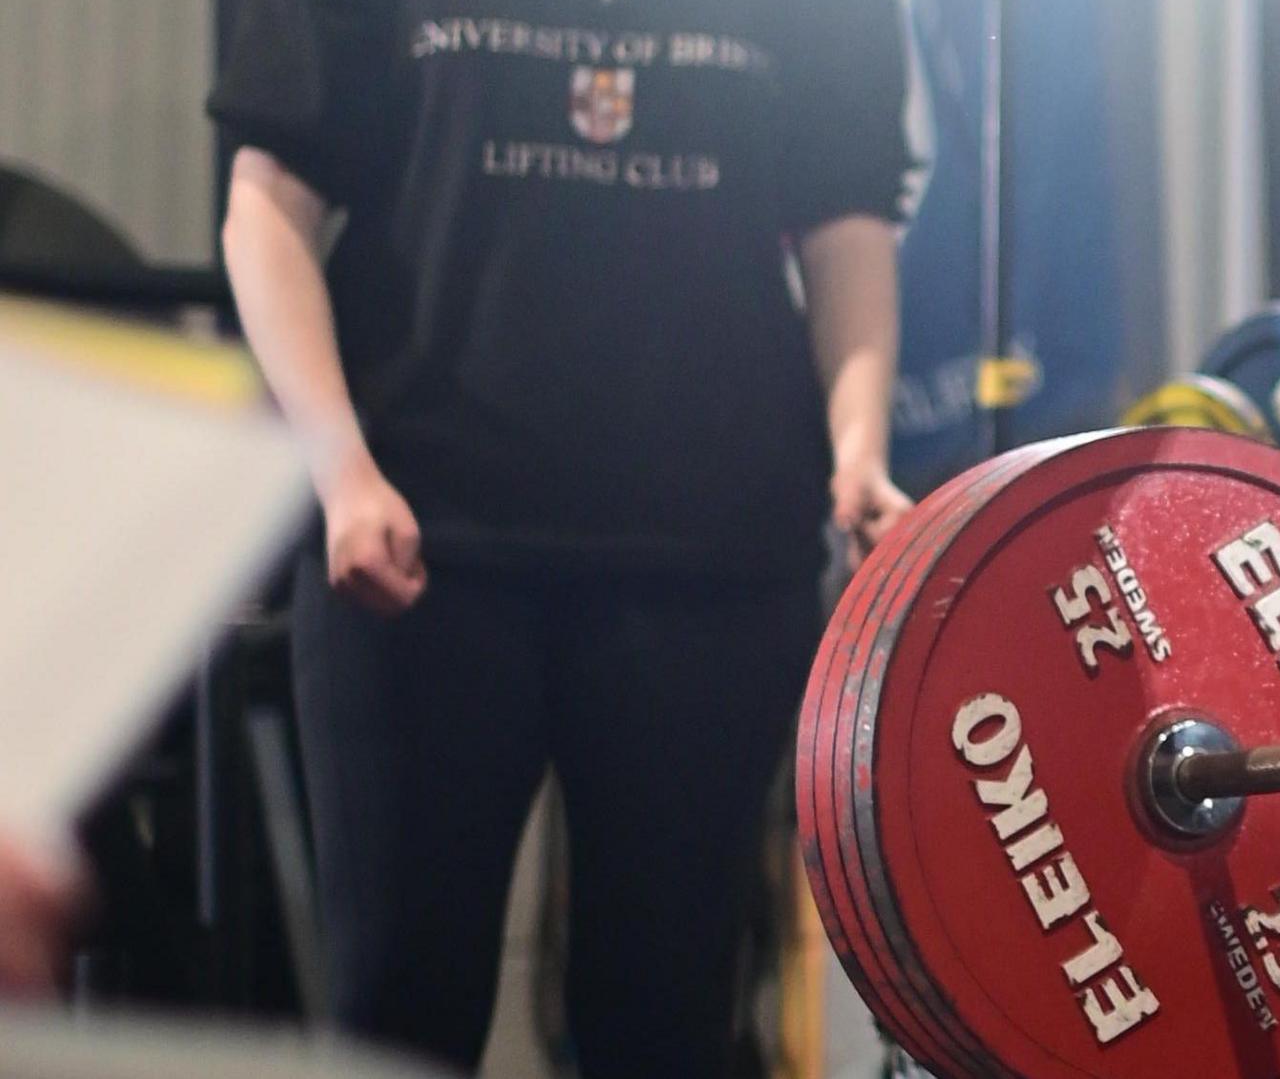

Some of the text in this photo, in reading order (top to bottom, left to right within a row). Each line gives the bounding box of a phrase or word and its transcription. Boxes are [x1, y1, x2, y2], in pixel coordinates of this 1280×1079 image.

[612, 30, 658, 64] OF
[483, 142, 720, 190] LIFTING CLUB
[1053, 564, 1132, 666] 25
[1098, 524, 1172, 662] SWEDEN
[951, 692, 1161, 1043] ELEIKO
